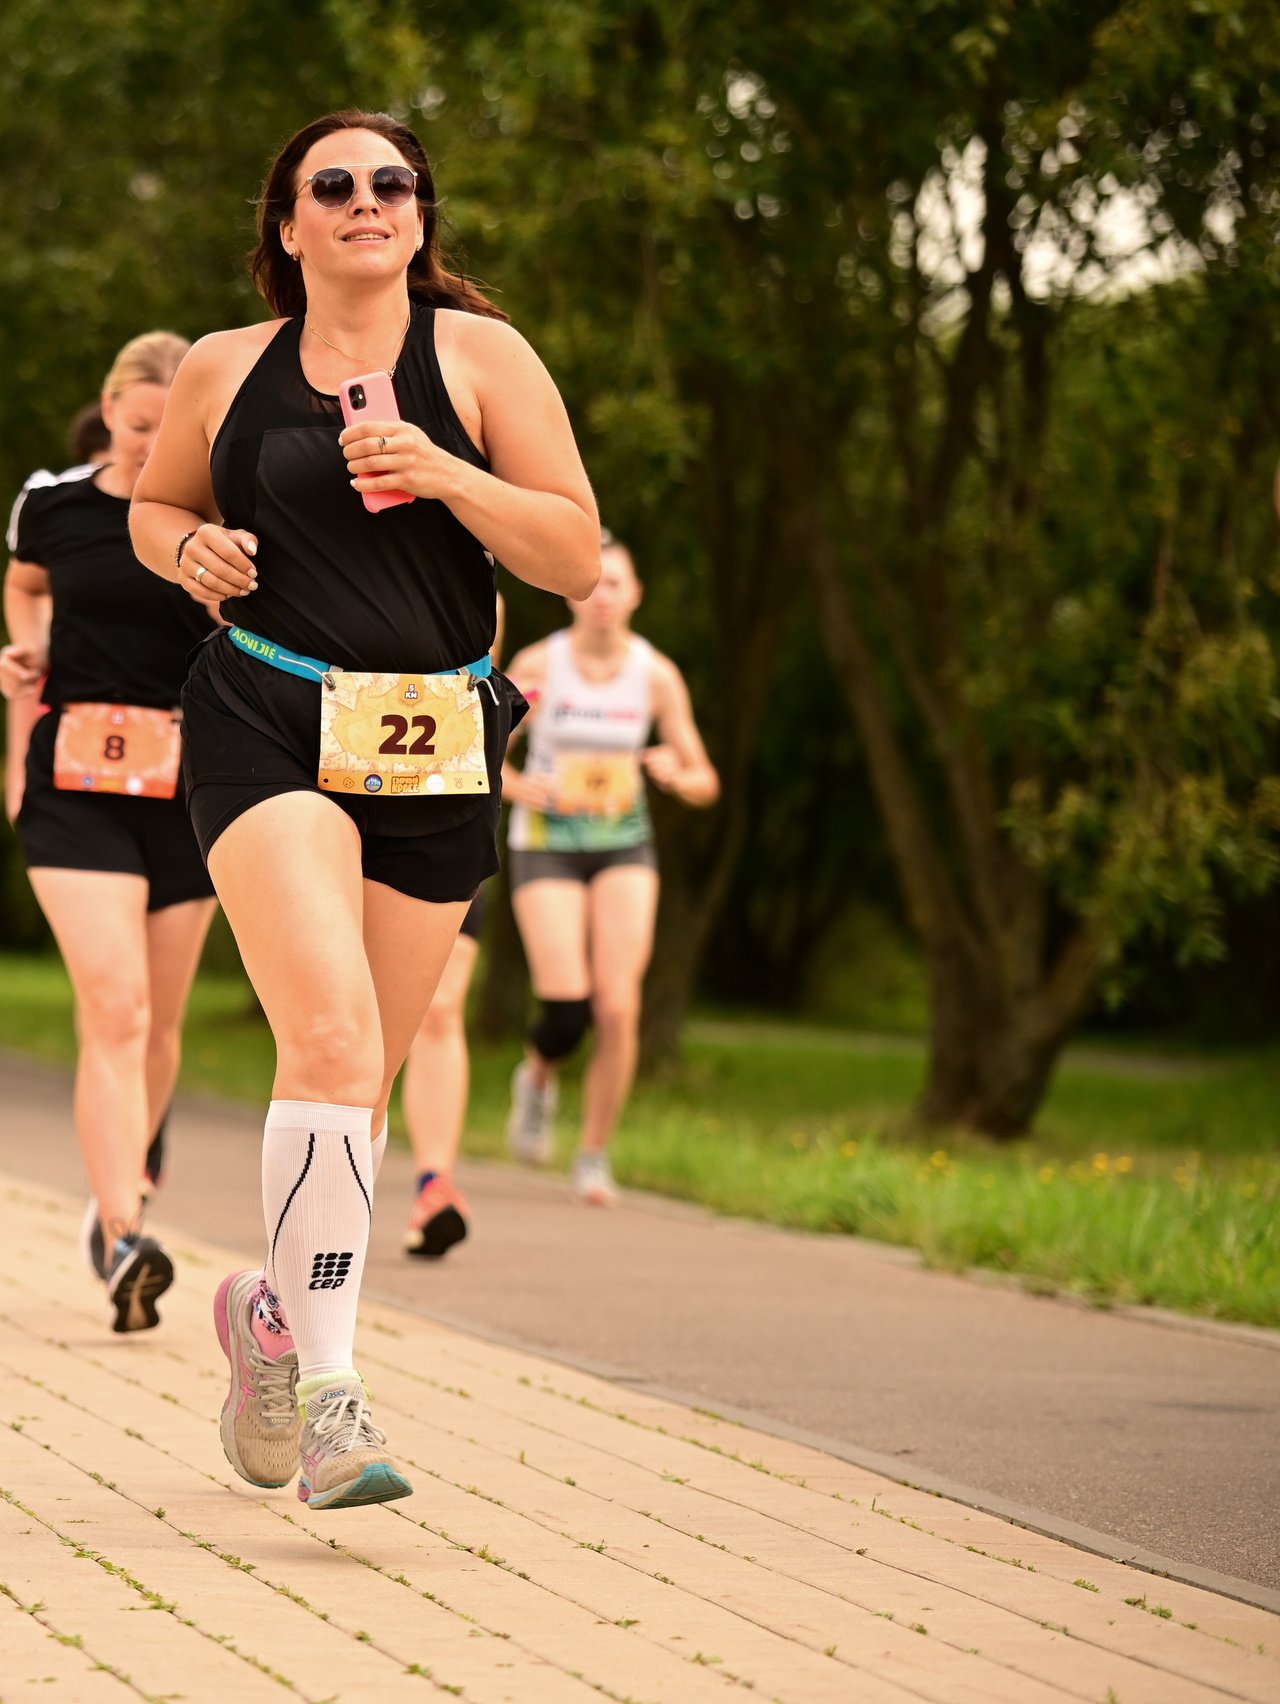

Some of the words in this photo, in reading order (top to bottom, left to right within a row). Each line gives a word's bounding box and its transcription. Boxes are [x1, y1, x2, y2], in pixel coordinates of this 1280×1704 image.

[232, 629, 276, 659] AONIJIE
[104, 735, 125, 760] 8
[378, 714, 437, 755] 22
[308, 1278, 345, 1290] cep
